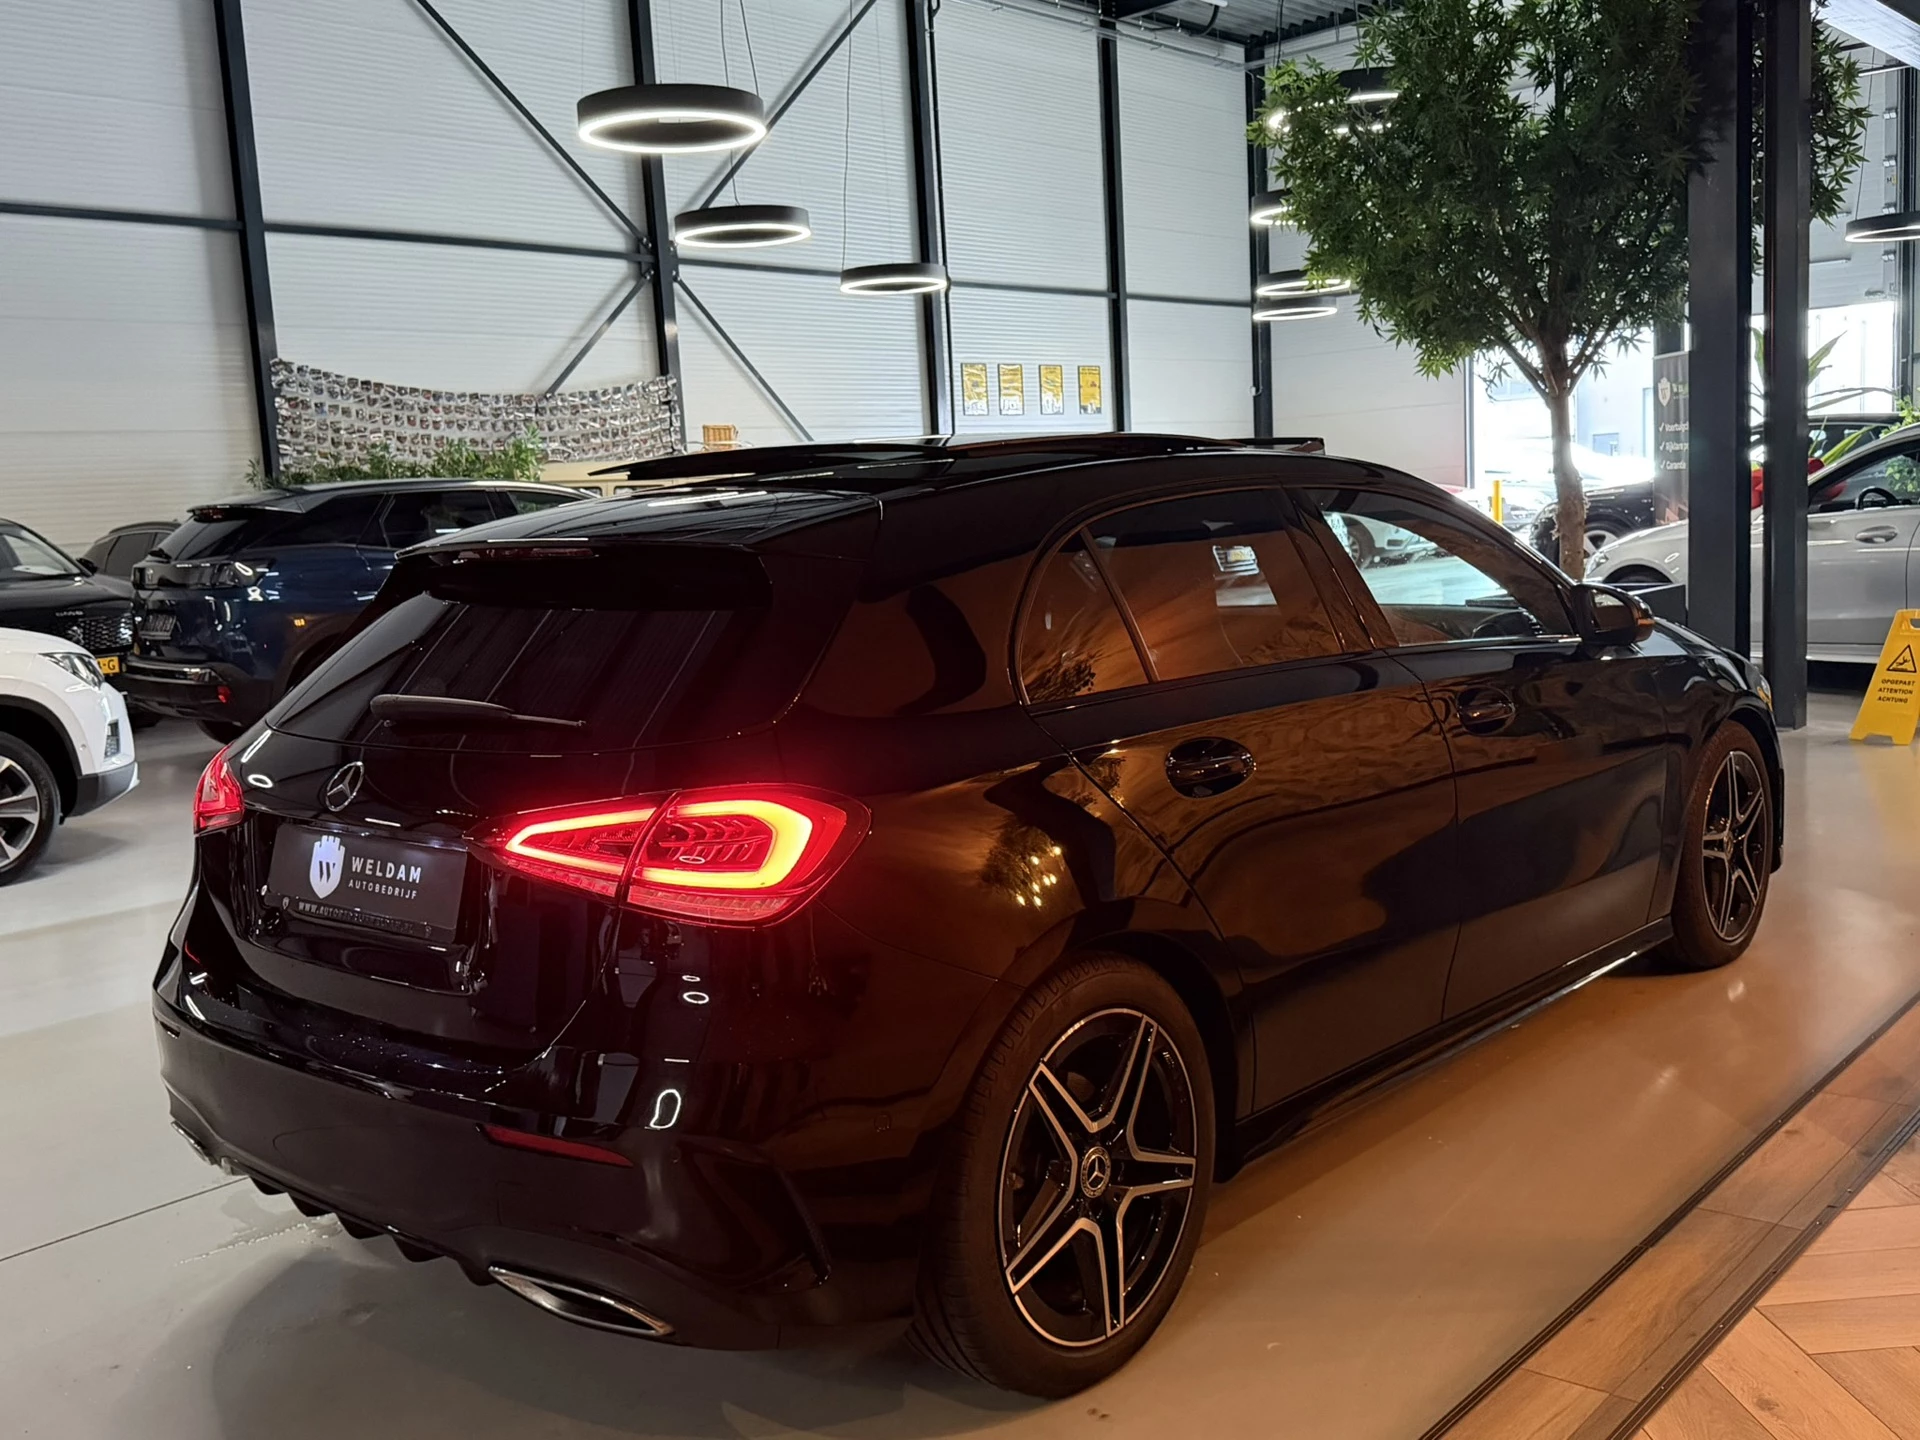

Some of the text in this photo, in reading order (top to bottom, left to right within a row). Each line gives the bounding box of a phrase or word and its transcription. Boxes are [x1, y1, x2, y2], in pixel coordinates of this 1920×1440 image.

[1881, 679, 1915, 687] OPGEPAST
[1878, 687, 1913, 695] ATTENTION
[1877, 696, 1908, 704] ACHTUNG
[351, 856, 421, 883] WELDAM
[348, 879, 417, 900] AUTOBEDRIJF
